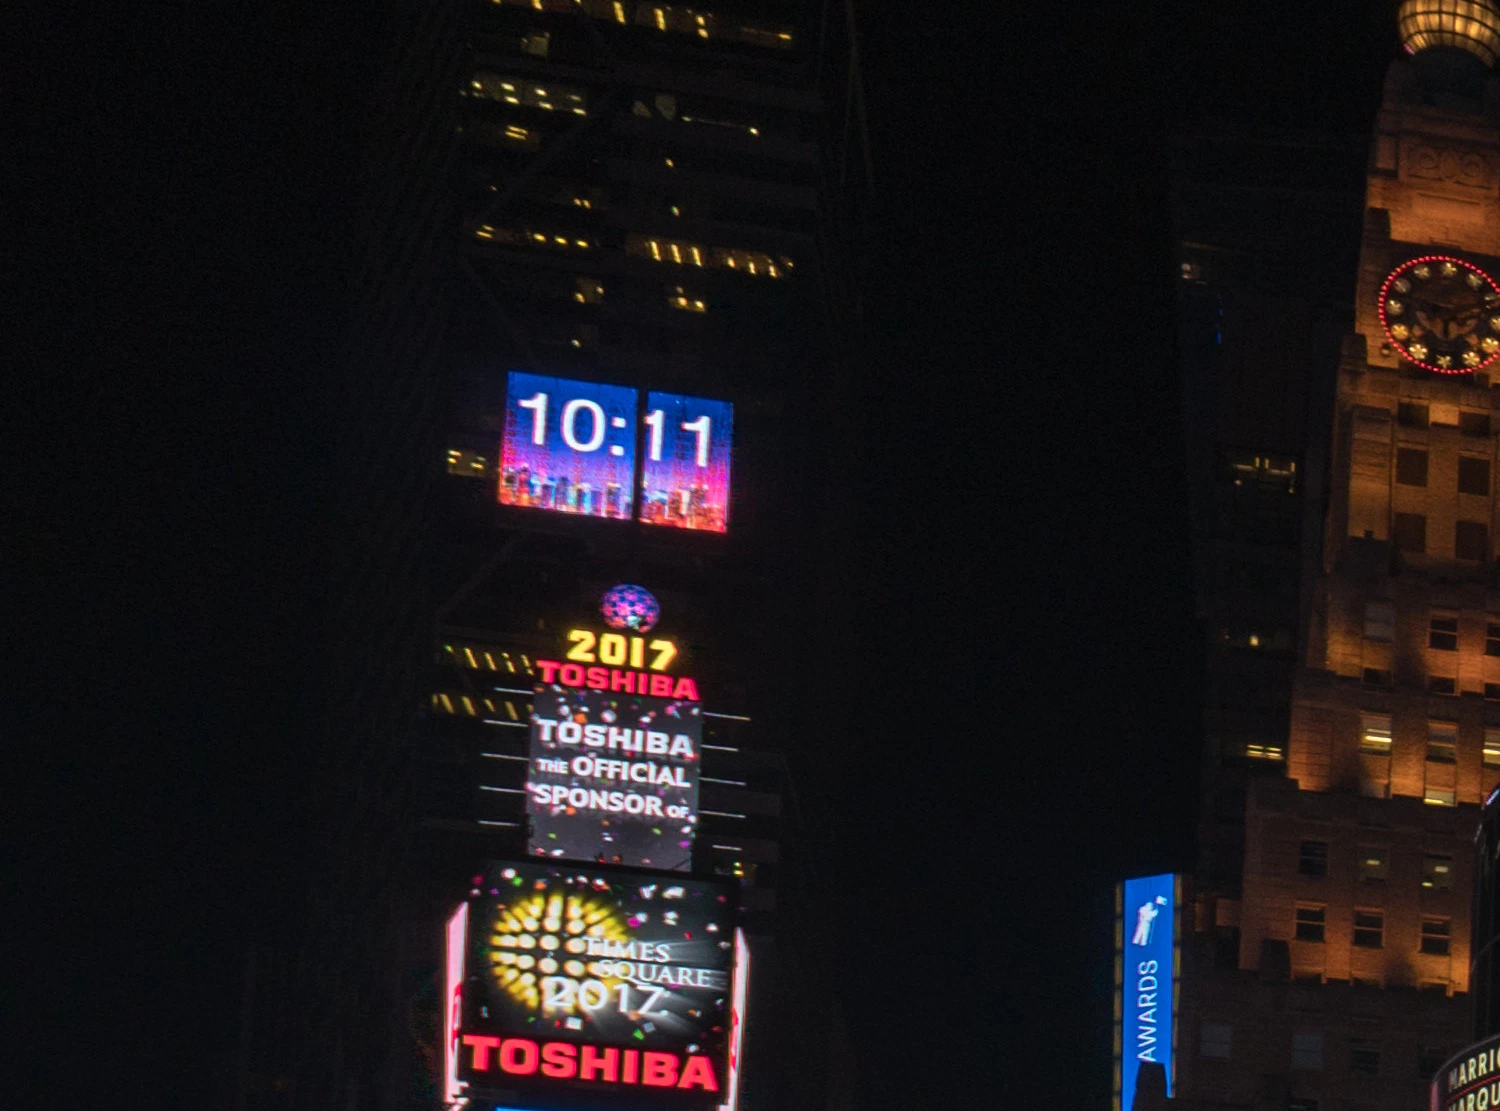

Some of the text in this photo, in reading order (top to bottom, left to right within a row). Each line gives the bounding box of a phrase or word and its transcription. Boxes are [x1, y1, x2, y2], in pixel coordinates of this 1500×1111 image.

[517, 391, 712, 468] 10:11
[566, 629, 678, 671] 2017
[536, 659, 699, 700] TOSHIBA
[539, 718, 696, 759] TOSHIBA
[537, 757, 691, 788] THE OFFICIAL
[534, 785, 690, 819] SPONSOR OF
[580, 936, 671, 962] TIMES
[598, 959, 710, 988] SQUARE
[543, 977, 667, 1017] 2017
[1137, 960, 1159, 1062] AWARDS
[463, 1034, 719, 1092] TOSHIBA
